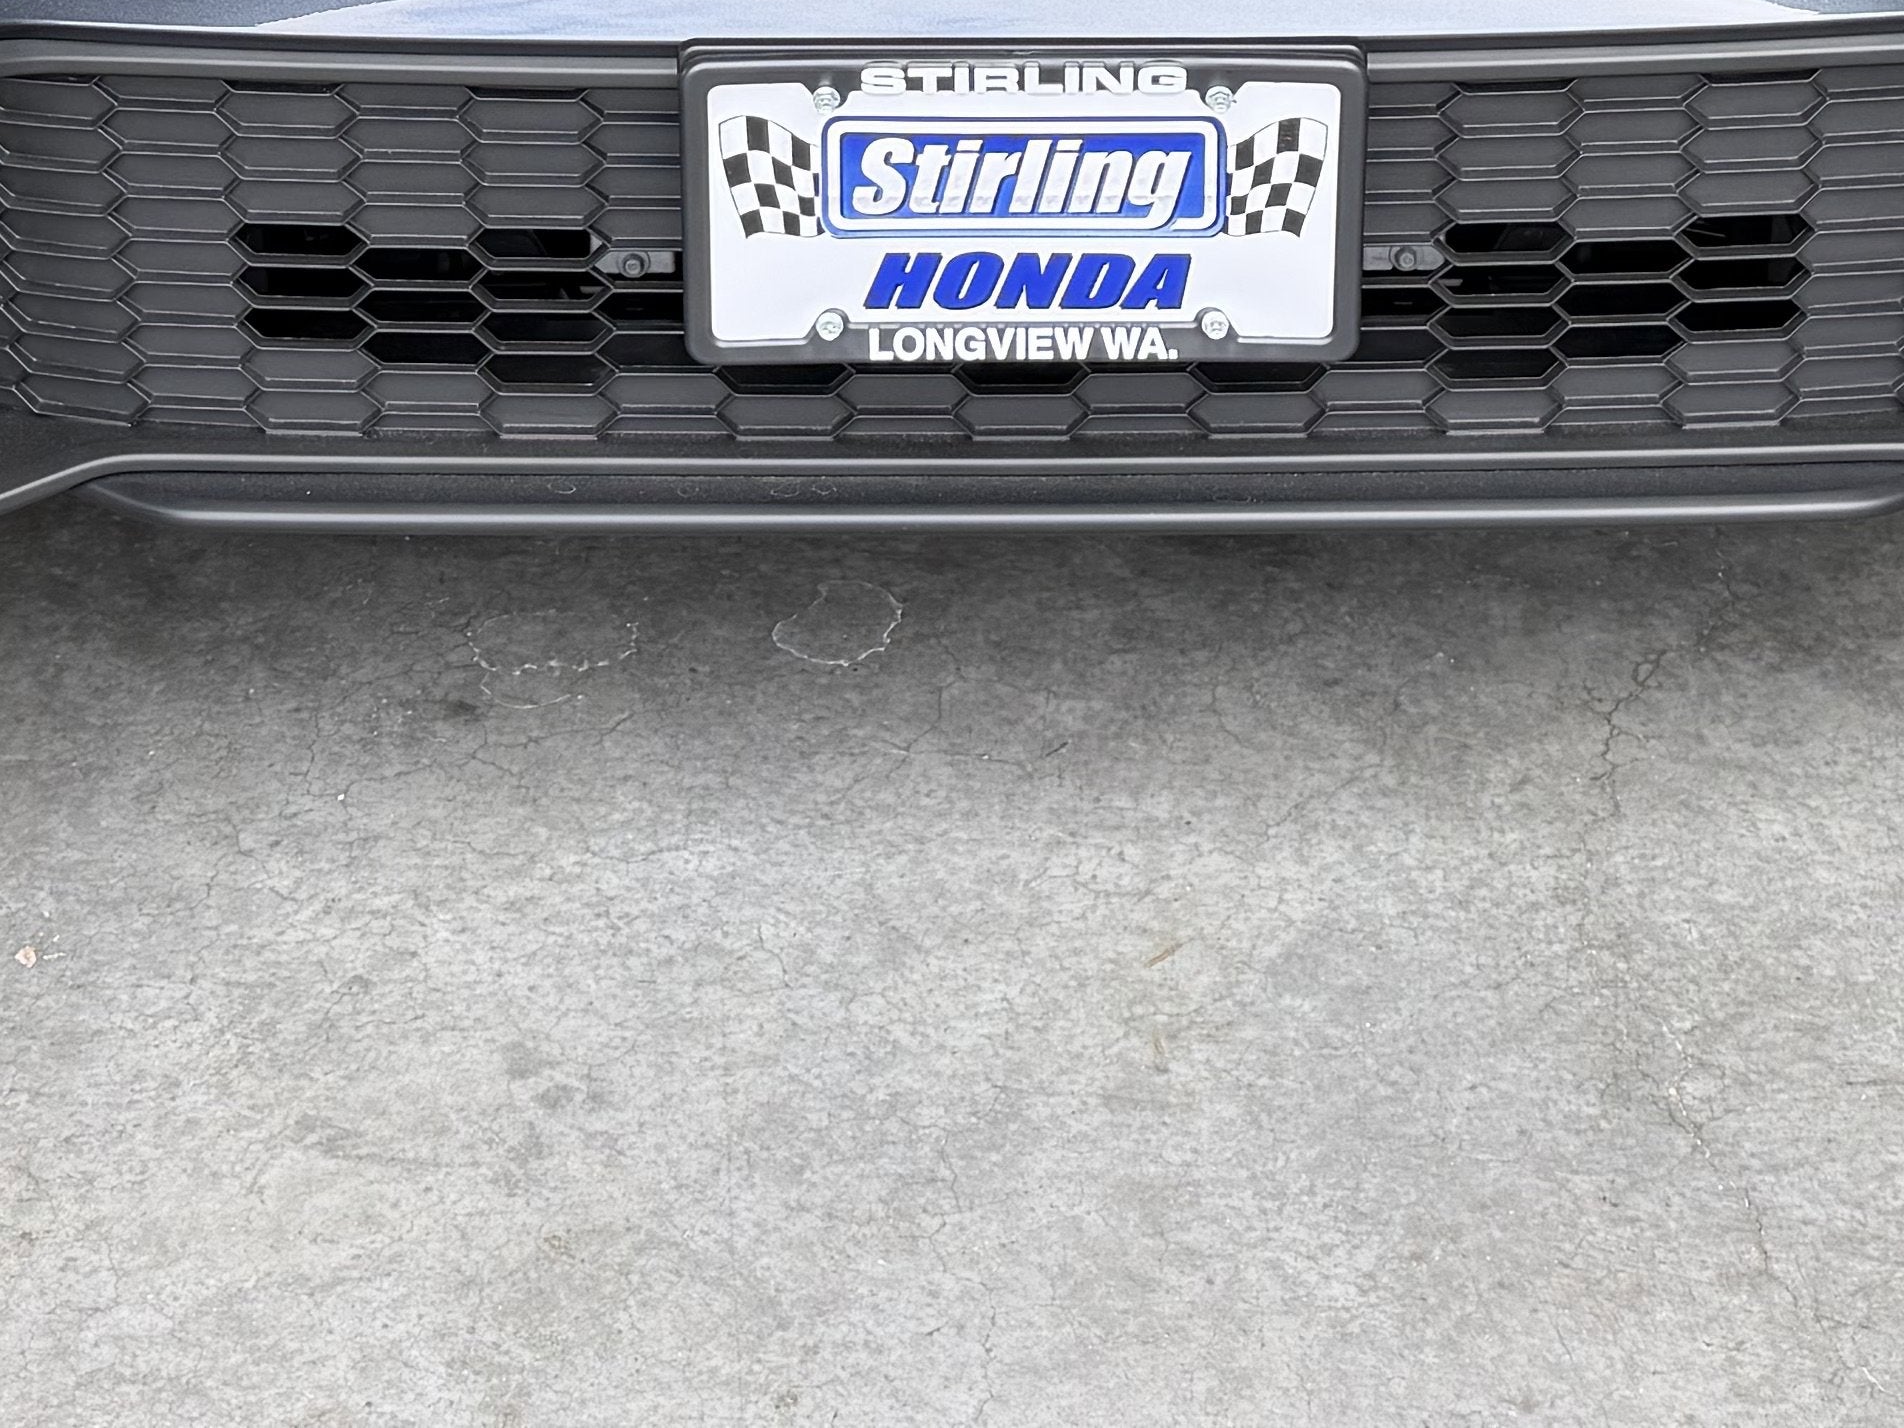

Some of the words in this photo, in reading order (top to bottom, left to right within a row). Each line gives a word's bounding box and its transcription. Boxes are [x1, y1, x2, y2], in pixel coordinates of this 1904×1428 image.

[859, 59, 1188, 97] STIRLING
[852, 137, 1192, 227] Stirling
[863, 252, 1192, 310] HONDA
[868, 326, 1093, 362] LONGVIEW
[1099, 326, 1179, 361] WA.
